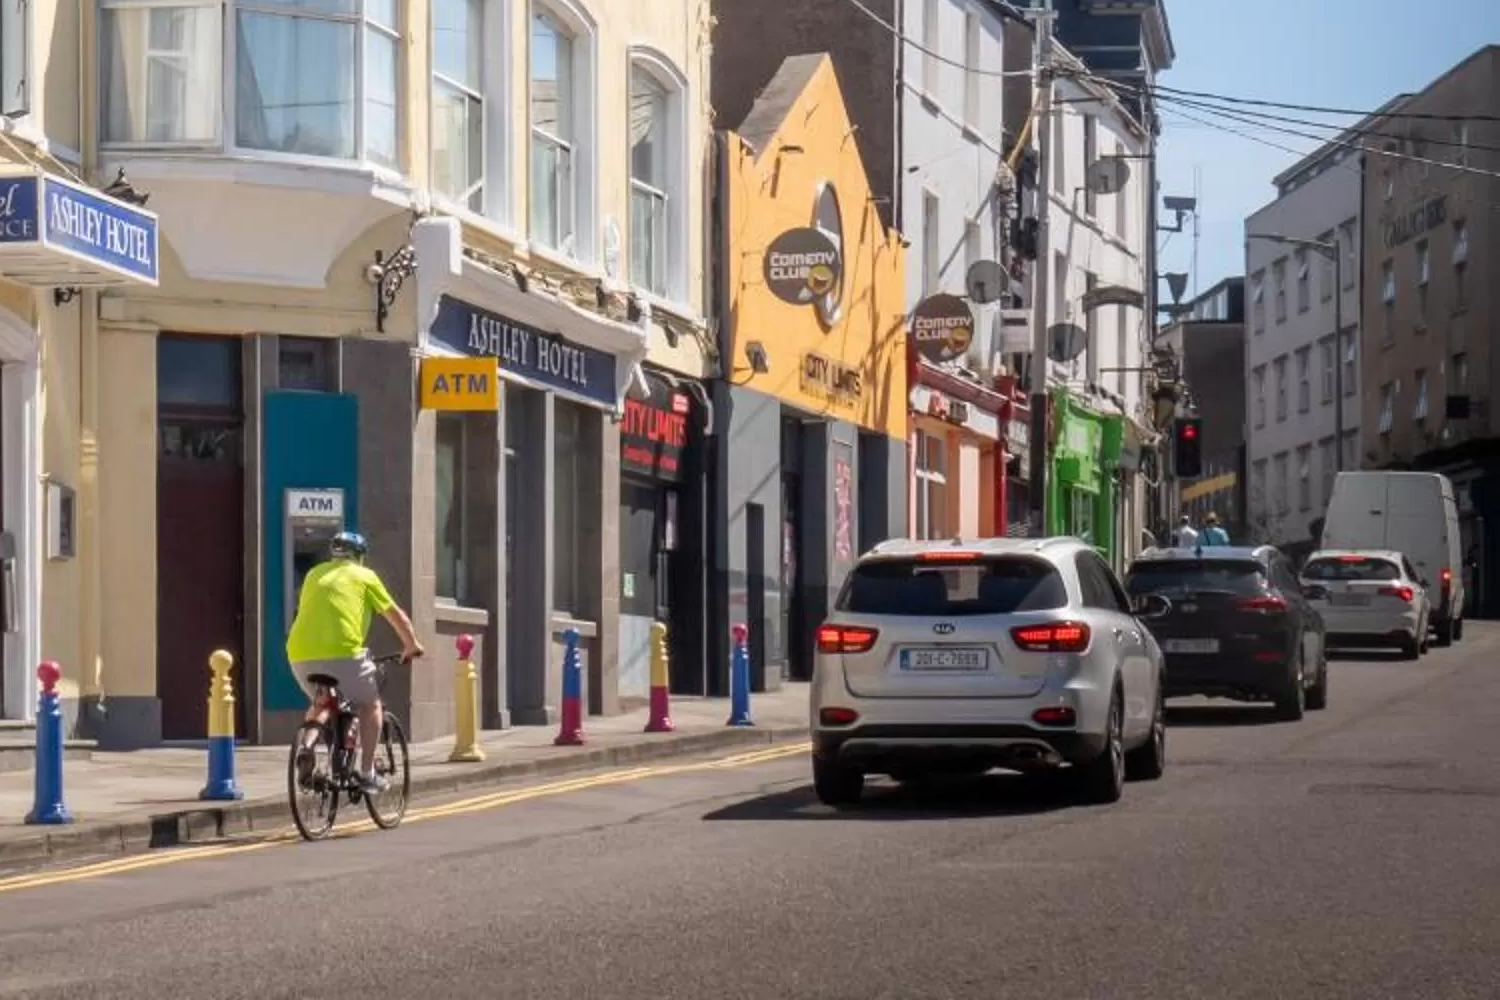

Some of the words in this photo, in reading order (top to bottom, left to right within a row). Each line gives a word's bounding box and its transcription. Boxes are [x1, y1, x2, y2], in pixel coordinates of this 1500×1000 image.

[50, 193, 104, 246] ASHLEY
[106, 214, 150, 265] HOTEL
[467, 313, 530, 366] ASHLEY
[537, 337, 588, 387] HOTEL
[432, 373, 488, 394] ATM
[298, 496, 334, 511] ATM
